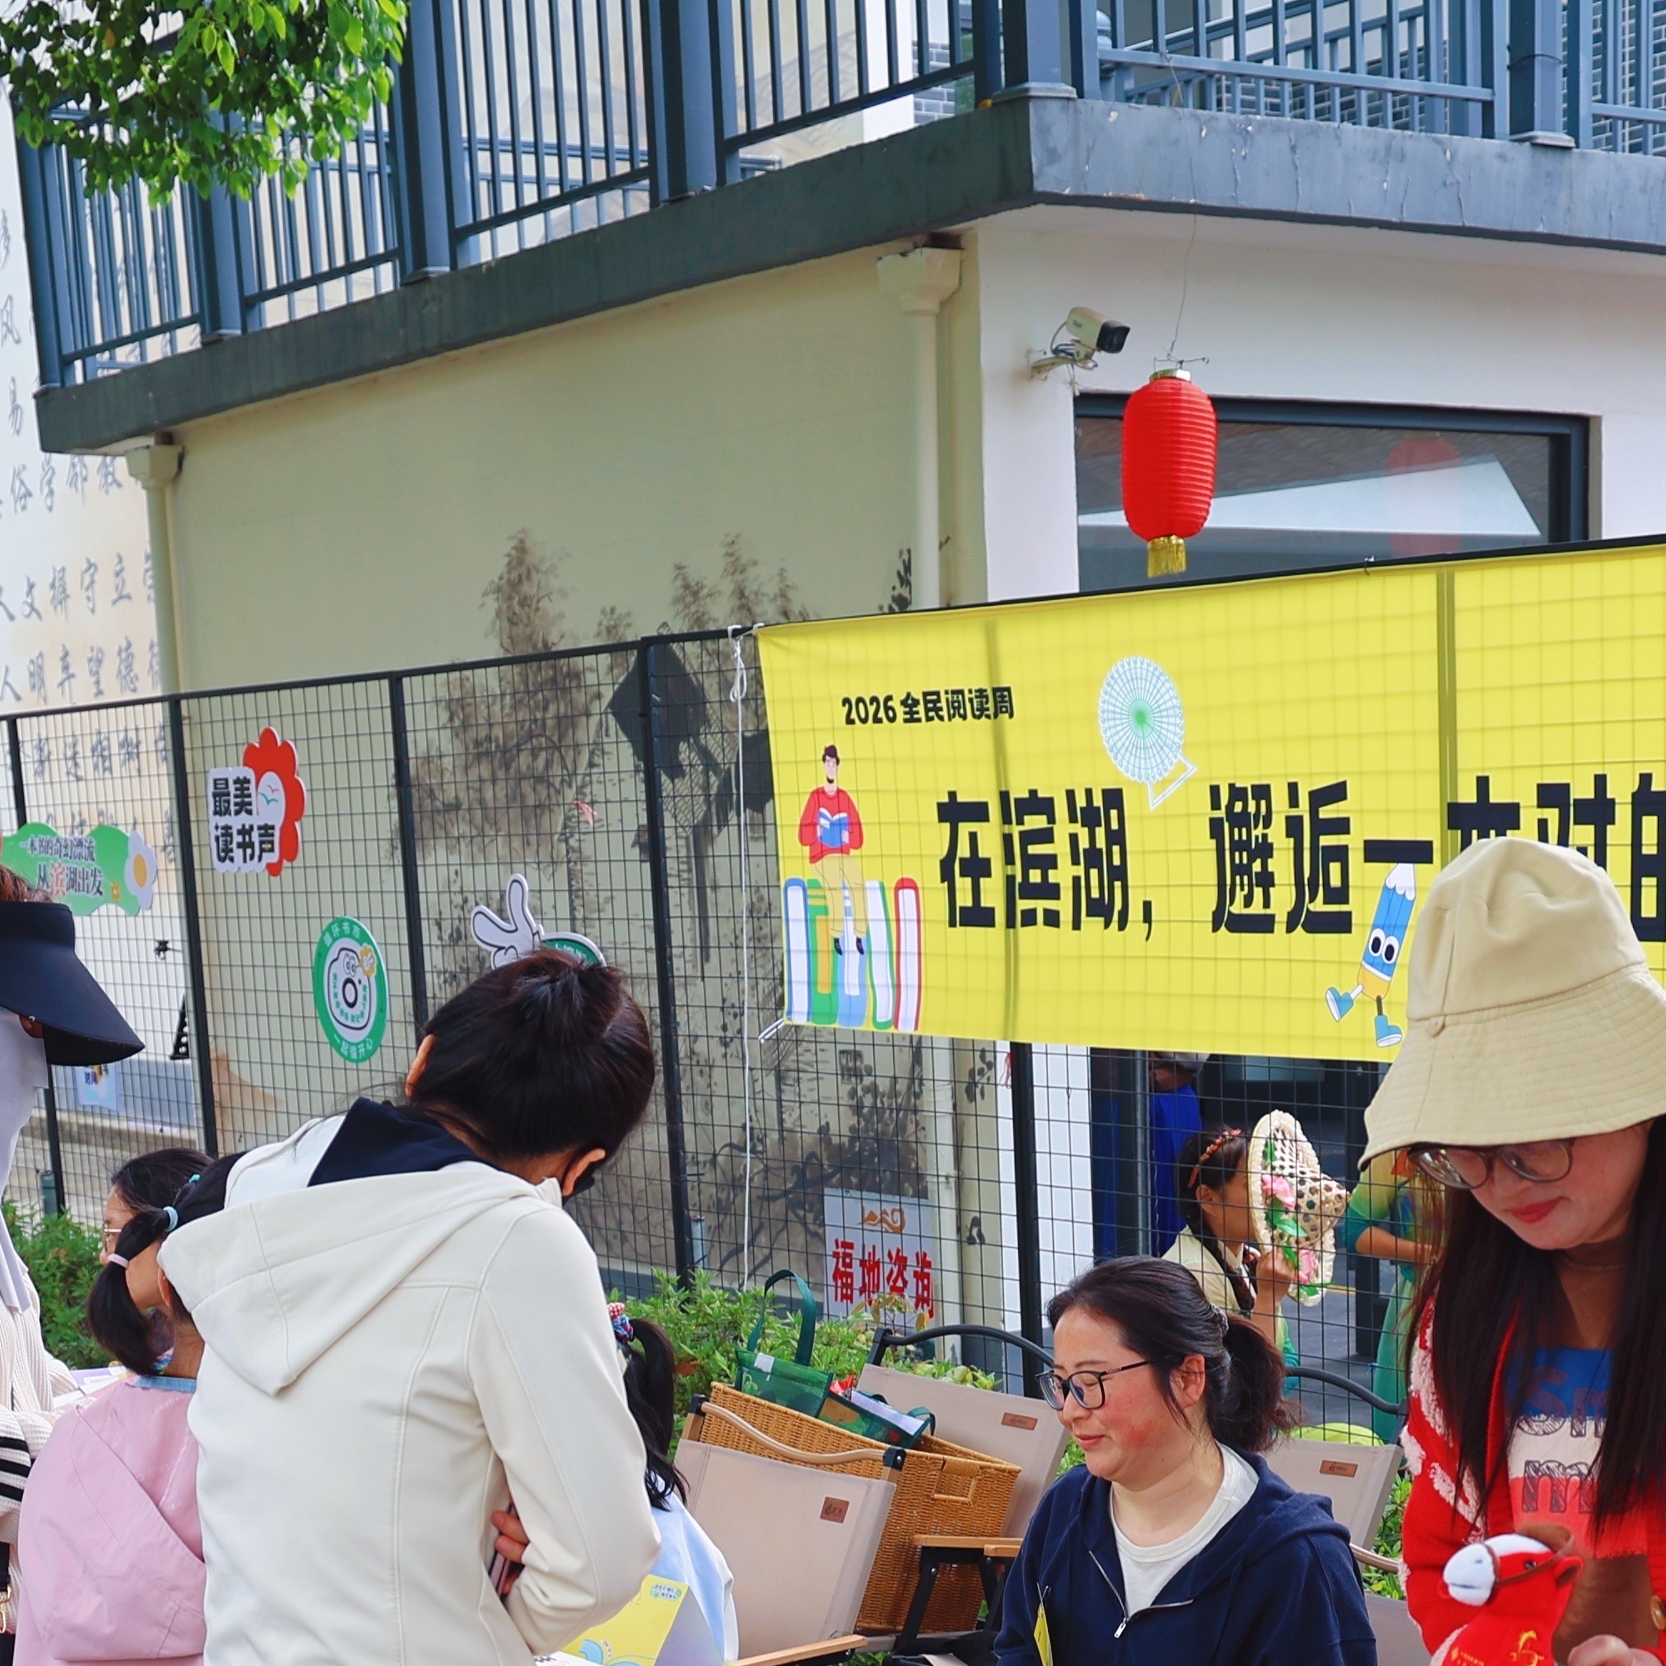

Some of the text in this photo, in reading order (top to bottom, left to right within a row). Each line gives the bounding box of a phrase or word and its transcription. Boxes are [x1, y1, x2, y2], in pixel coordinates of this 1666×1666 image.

[841, 685, 1015, 726] 2026 全民阅读周
[211, 775, 254, 817] 最美
[212, 820, 277, 864] 读书声
[37, 861, 103, 897] 从滨湖出发
[831, 1238, 935, 1319] 福地咨询
